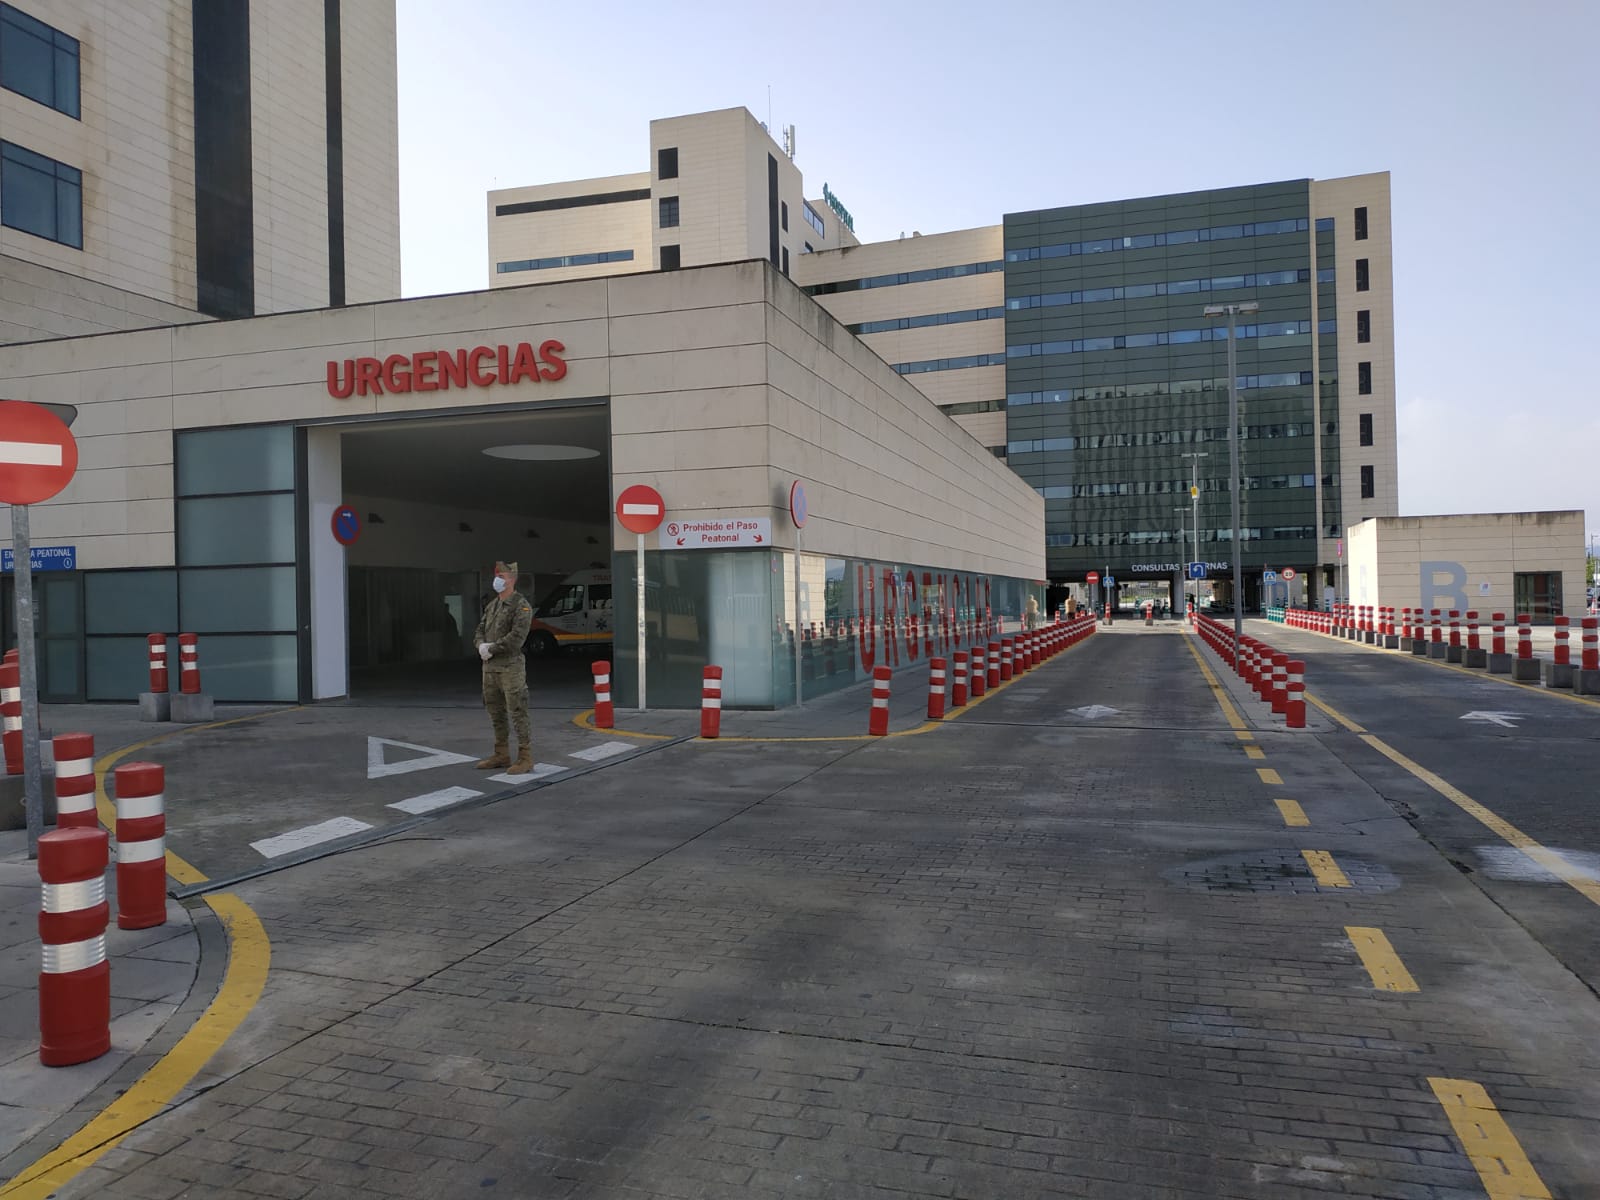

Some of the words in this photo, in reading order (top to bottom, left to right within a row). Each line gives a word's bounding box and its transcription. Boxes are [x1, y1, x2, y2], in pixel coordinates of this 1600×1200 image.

[327, 340, 567, 399] URGENCIAS
[683, 523, 723, 532] Prohibido
[726, 522, 734, 530] el
[737, 521, 758, 530] Paso
[702, 534, 739, 543] Peatonal
[36, 548, 71, 558] PEATONAL
[4, 560, 42, 570] URIAS
[1132, 564, 1180, 572] CONSULTAS
[1420, 561, 1469, 622] B
